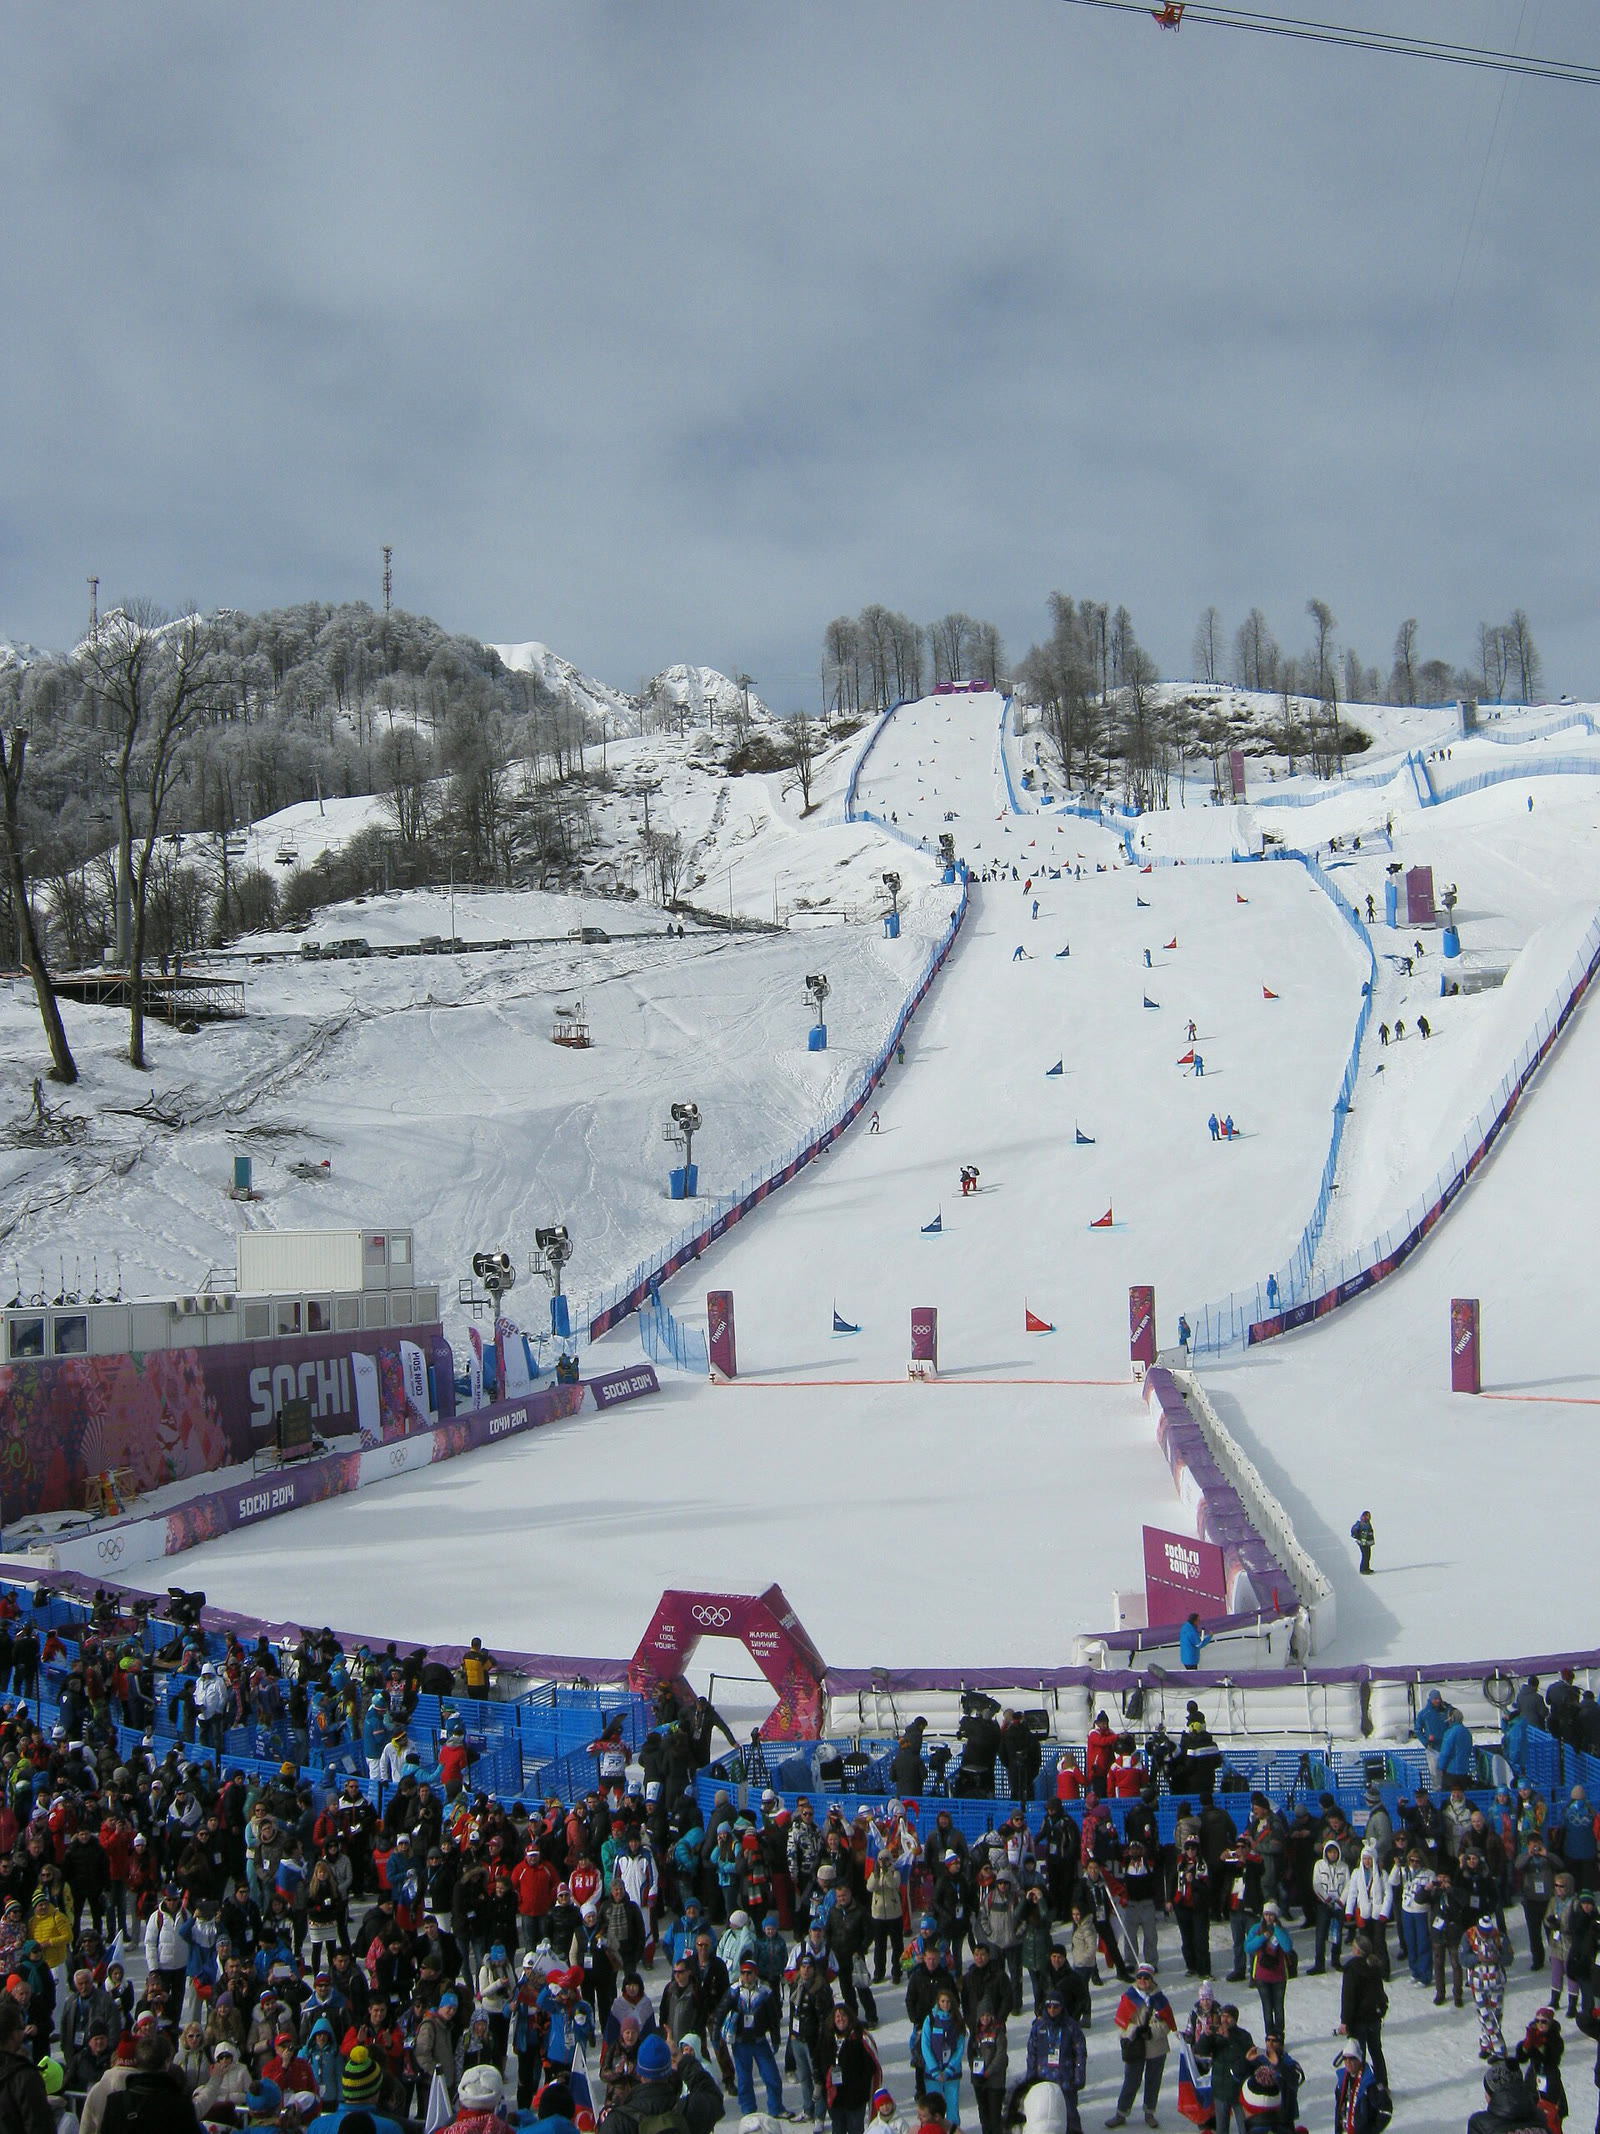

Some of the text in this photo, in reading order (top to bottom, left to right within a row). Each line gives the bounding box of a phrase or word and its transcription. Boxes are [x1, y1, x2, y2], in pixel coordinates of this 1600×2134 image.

[712, 1320, 727, 1343] FINISH
[1454, 1330, 1473, 1355] FINISH
[249, 1357, 351, 1428] SOCHI
[602, 1373, 653, 1400] SOCHI 2014
[489, 1408, 528, 1435] СОЧИ 2014
[239, 1483, 294, 1519] SOCHI 2014
[1164, 1543, 1200, 1566] sochi.ru
[1169, 1557, 1189, 1580] 2014
